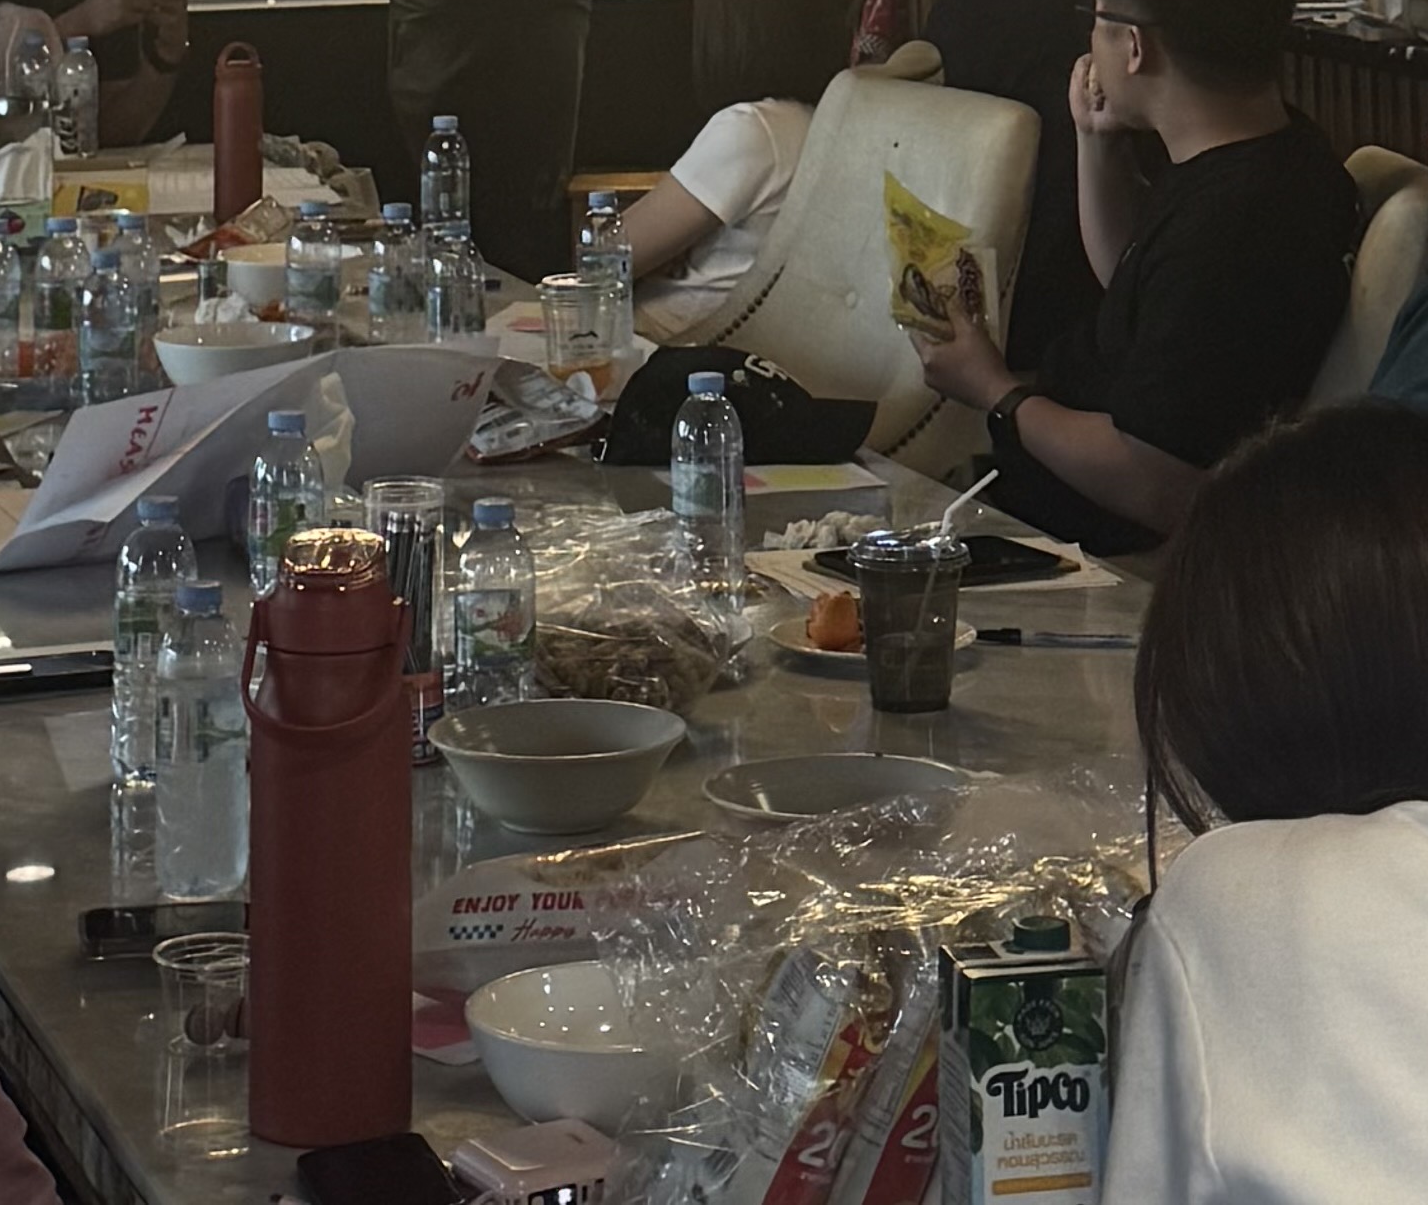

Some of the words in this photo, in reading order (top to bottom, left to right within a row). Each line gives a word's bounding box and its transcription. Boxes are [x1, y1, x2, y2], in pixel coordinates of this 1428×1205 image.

[451, 893, 521, 915] ENJOY
[510, 917, 577, 942] Happy
[985, 1067, 1091, 1119] Tipco
